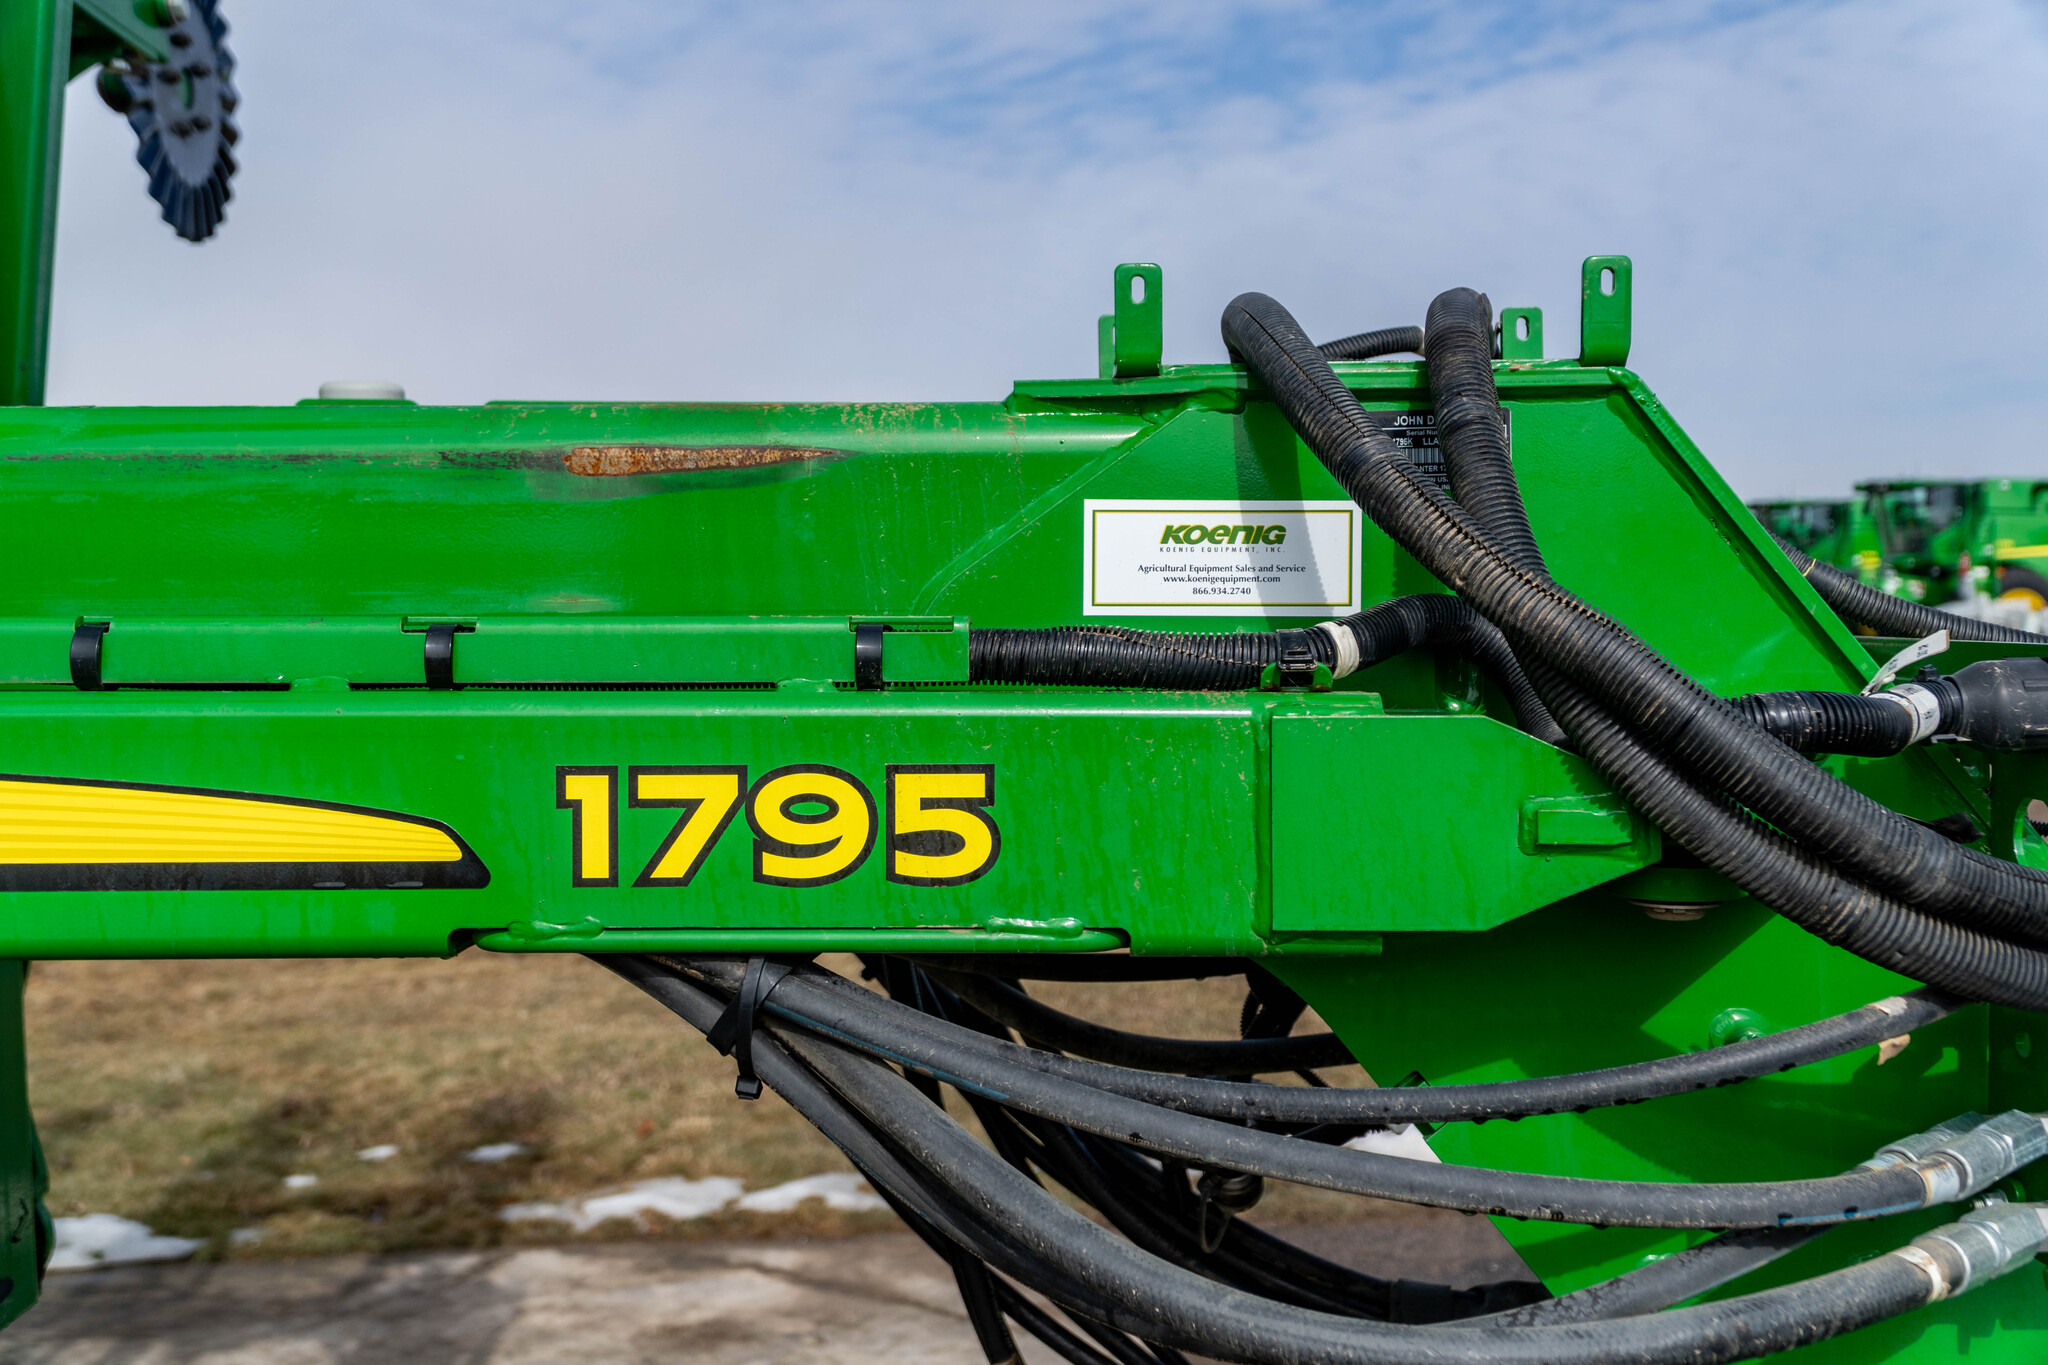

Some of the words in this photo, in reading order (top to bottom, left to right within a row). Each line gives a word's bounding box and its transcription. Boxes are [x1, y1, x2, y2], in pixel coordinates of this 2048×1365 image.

[1394, 415, 1423, 426] JOHN
[1201, 546, 1259, 554] EQUIPMENT,
[1137, 564, 1187, 574] Agricultural
[1189, 564, 1233, 574] Equipment
[1235, 564, 1256, 572] Sales
[1258, 564, 1273, 572] and
[1276, 564, 1306, 572] Service
[1163, 574, 1281, 585] www.koenigequipment.com
[1192, 587, 1252, 595] 866.934.2740
[556, 763, 1001, 888] 1795
